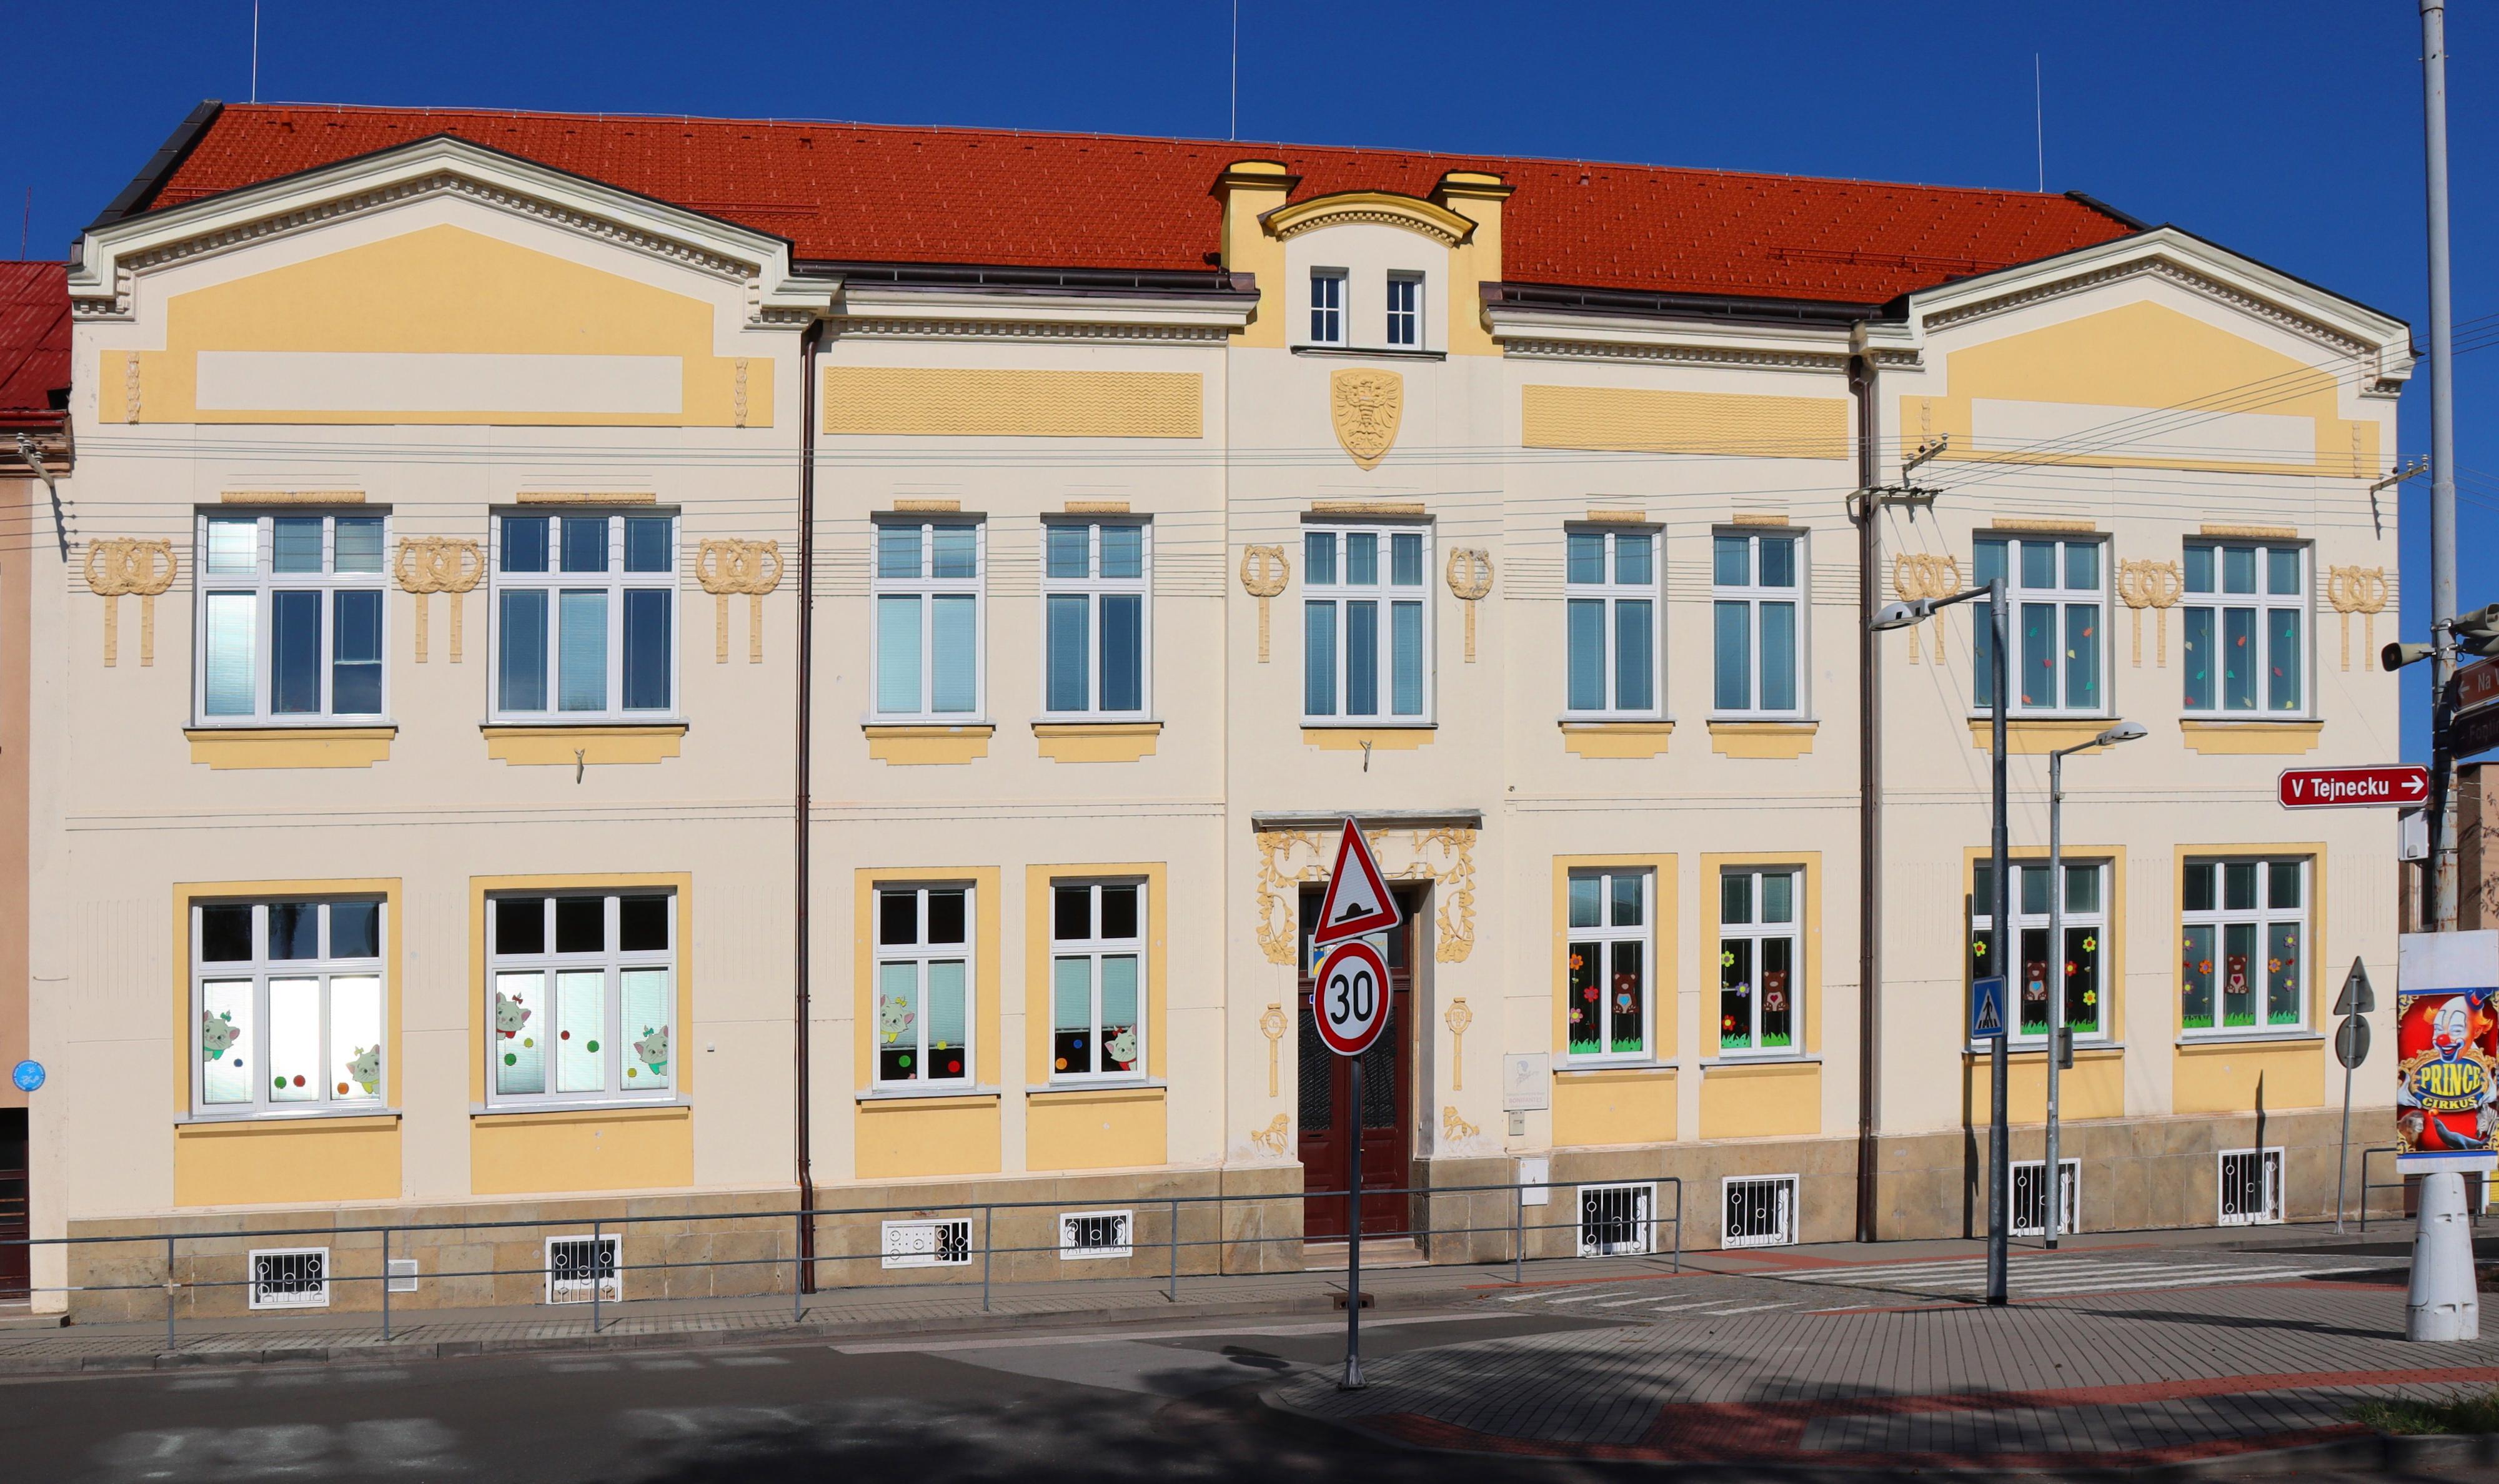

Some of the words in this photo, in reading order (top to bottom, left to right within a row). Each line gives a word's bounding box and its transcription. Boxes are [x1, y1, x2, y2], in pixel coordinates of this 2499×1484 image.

[2478, 673, 2491, 692] Na
[2292, 779, 2304, 798] V
[2311, 777, 2390, 801] Tejnecku
[1329, 970, 1373, 1025] 30
[2420, 1064, 2482, 1096] PRINCE
[2422, 1097, 2478, 1109] CIRKUS
